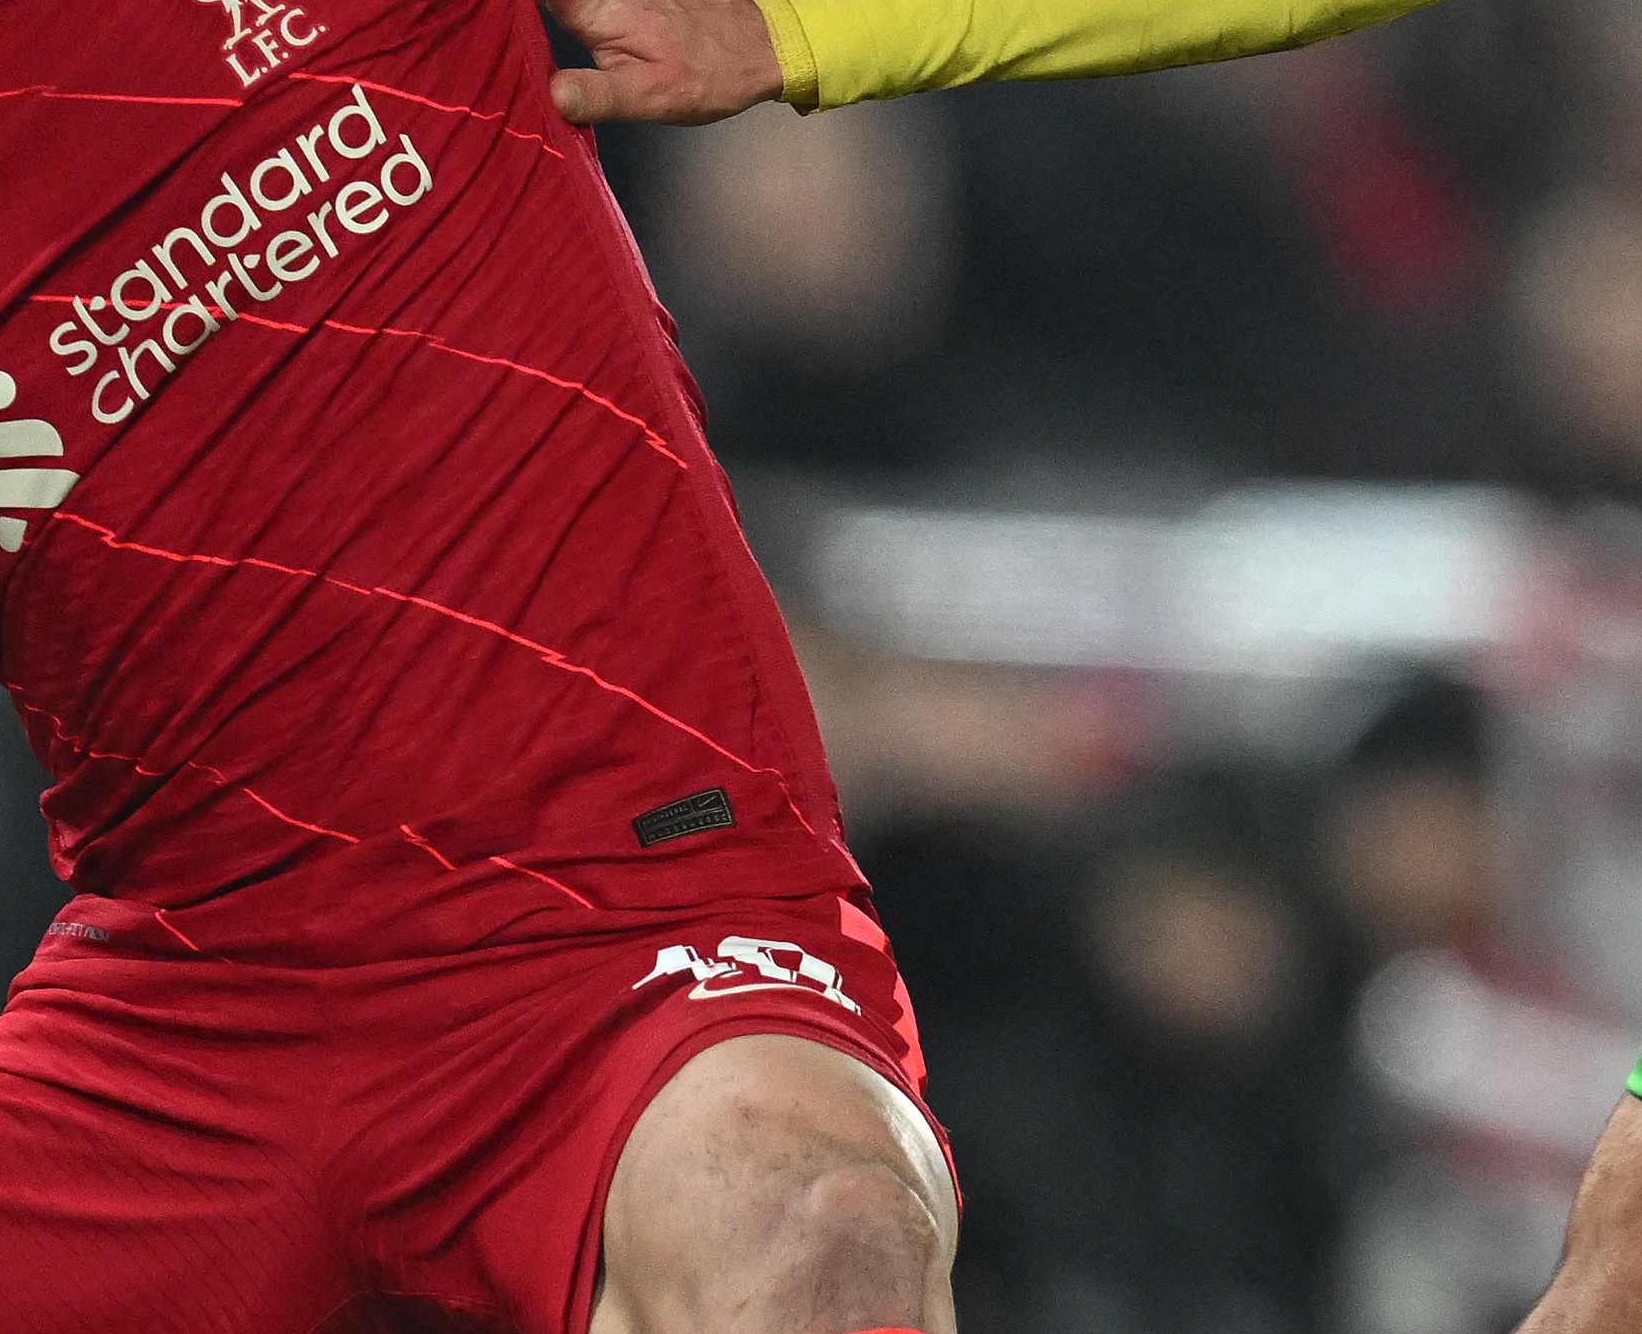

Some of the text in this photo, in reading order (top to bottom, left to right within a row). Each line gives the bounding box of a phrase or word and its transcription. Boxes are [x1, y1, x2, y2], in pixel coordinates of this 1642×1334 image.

[225, 8, 327, 87] L.F.C.
[49, 84, 387, 376] standard
[91, 134, 433, 425] chartered
